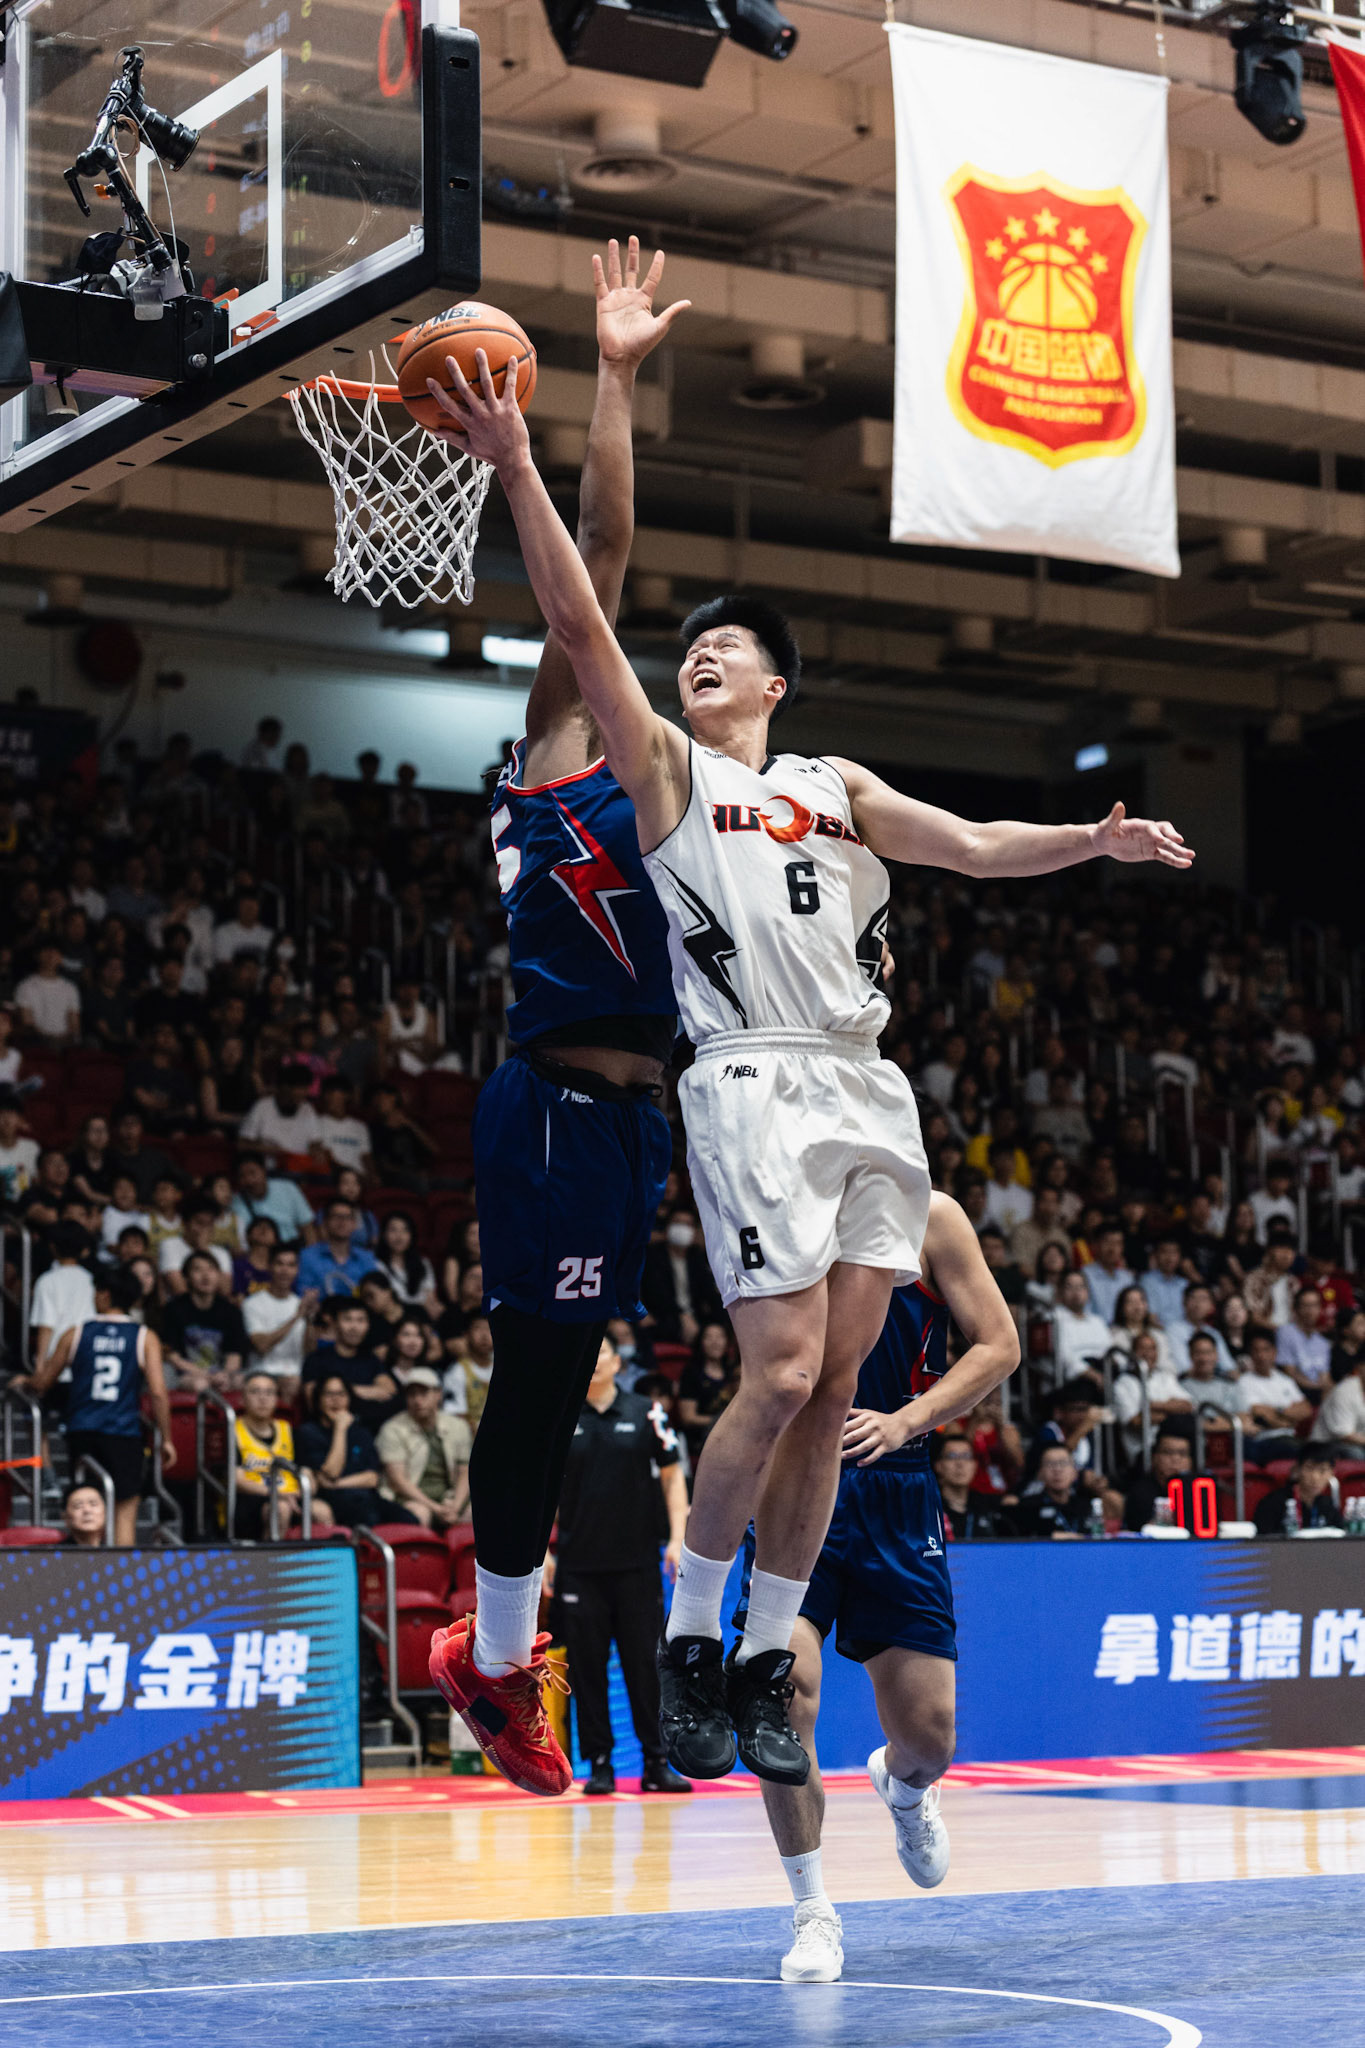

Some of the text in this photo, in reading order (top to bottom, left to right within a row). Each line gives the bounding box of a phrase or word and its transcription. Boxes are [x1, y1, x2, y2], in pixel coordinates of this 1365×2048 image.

[968, 364, 1034, 399] CHINESE
[1003, 396, 1103, 425] ASSOCIATION
[784, 861, 820, 915] 6
[733, 1065, 759, 1079] NBL
[739, 1226, 765, 1270] 6
[555, 1256, 603, 1300] 25
[91, 1355, 122, 1402] 2
[1094, 1609, 1365, 1685] 拿道德的
